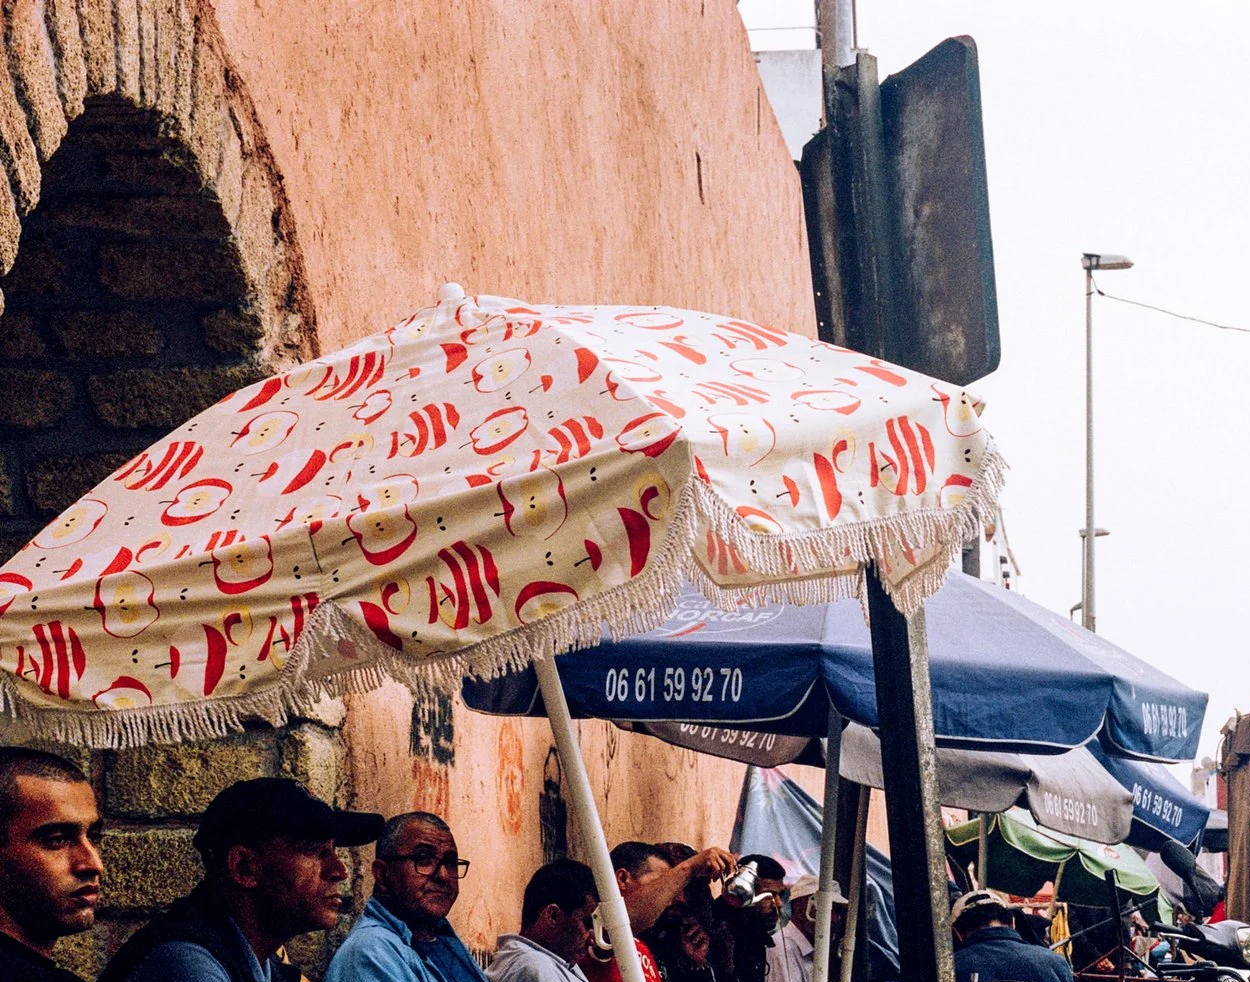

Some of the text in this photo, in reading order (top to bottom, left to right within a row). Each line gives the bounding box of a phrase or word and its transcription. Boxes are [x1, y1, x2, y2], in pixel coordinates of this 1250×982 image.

[605, 667, 743, 703] 06 61 59 92 70
[1178, 706, 1187, 738] 70
[1064, 798, 1074, 821] 59
[1075, 800, 1085, 824] 92
[1086, 803, 1097, 827] 70
[1133, 782, 1183, 828] 06 61 59 92 70
